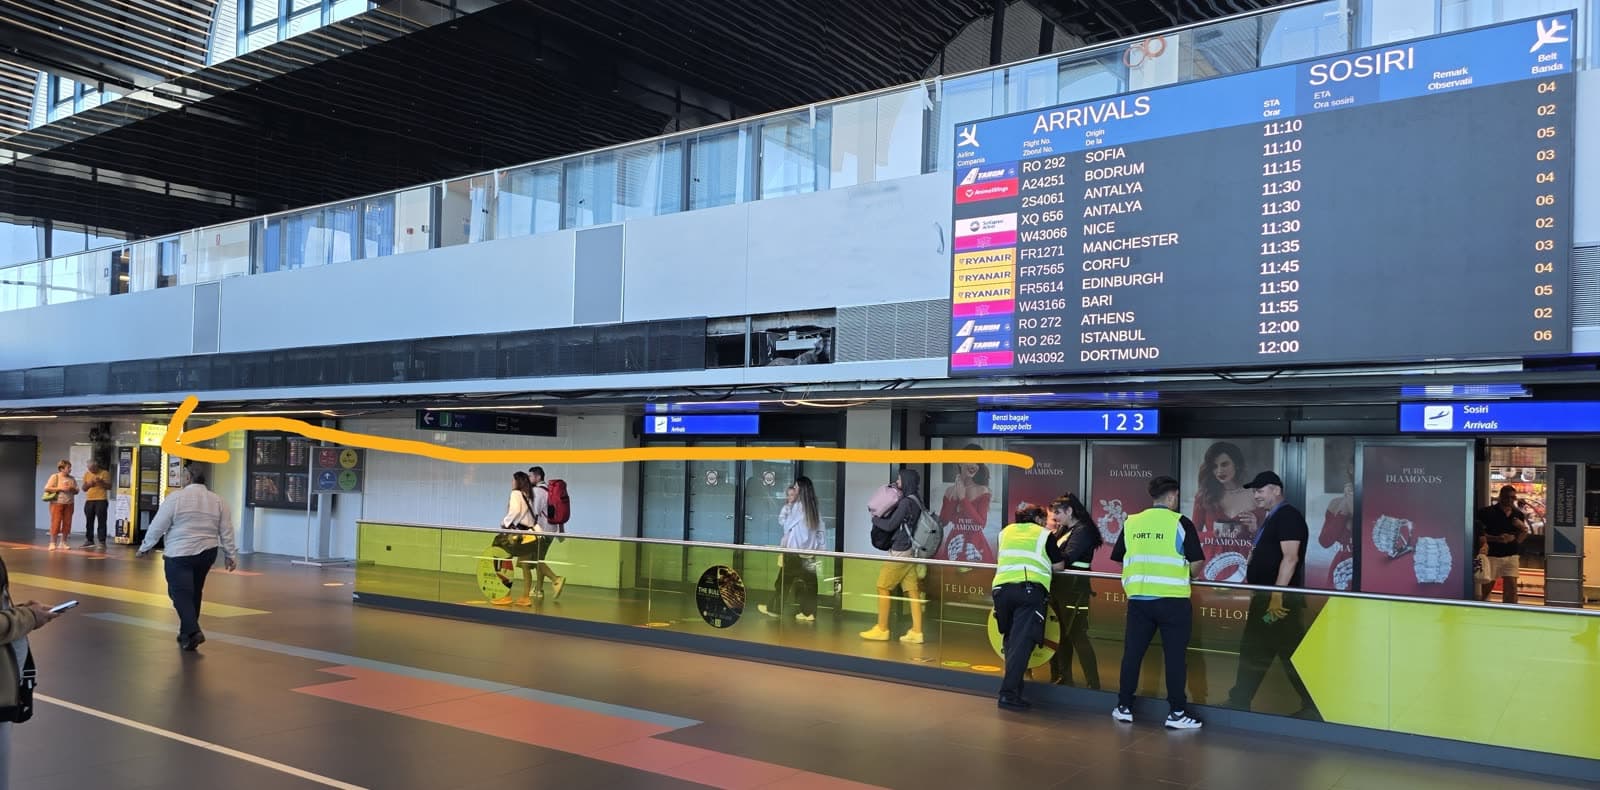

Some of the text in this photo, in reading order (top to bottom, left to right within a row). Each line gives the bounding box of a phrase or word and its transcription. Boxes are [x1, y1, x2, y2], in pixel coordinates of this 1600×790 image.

[1538, 52, 1557, 62] Belt
[1309, 47, 1415, 86] SOSIRI
[1433, 66, 1468, 79] Remark
[1531, 63, 1563, 74] Banda
[1537, 81, 1556, 94] 04
[1314, 90, 1331, 99] ETA
[1263, 99, 1280, 107] STA
[1313, 101, 1329, 109] Ora
[1033, 96, 1150, 134] ARRIVALS
[1263, 109, 1280, 117] Orar
[1537, 104, 1556, 116] 02
[1085, 129, 1104, 138] Origin
[1264, 119, 1302, 137] 11:10
[1536, 127, 1555, 139] 05
[1023, 140, 1039, 149] Flight
[1263, 139, 1302, 157] 11:10
[957, 151, 974, 159] Airline
[1085, 147, 1126, 164] SOFIA
[1536, 150, 1555, 161] 03
[1022, 157, 1066, 173] RO 292
[1085, 162, 1145, 181] BODRUM
[1262, 160, 1301, 177] 11:15
[1022, 175, 1065, 190] A24251
[1536, 172, 1555, 184] 04
[1084, 181, 1143, 200] ANTALYA
[1262, 180, 1301, 196] 11:30
[1022, 192, 1064, 208] 2S4061
[1535, 194, 1554, 206] 06
[1083, 200, 1142, 218] ANTALYA
[1261, 199, 1300, 216] 11:30
[1021, 210, 1063, 225] XQ 656
[1535, 217, 1554, 229] 02
[1083, 221, 1116, 236] NICE
[1261, 219, 1300, 236] 11:30
[1020, 227, 1067, 243] W43066
[1083, 233, 1179, 254] MANCHESTER
[1260, 239, 1300, 256] 11:35
[1535, 239, 1553, 251] 03
[965, 254, 1012, 265] RYANAIR
[1020, 246, 1064, 260] FR1271
[1020, 263, 1064, 278] FR7565
[1082, 256, 1130, 272] CORFU
[1260, 259, 1300, 275] 11:45
[1534, 262, 1553, 274] 04
[965, 271, 1011, 282] RYANAIR
[1082, 272, 1164, 290] EDINBURGH
[964, 288, 1010, 299] RYANAIR
[1019, 281, 1064, 295] FR5614
[1259, 279, 1299, 295] 11:50
[1534, 285, 1553, 296] 05
[1019, 299, 1066, 312] W43166
[1082, 295, 1113, 308] BARI
[1259, 300, 1299, 315] 11:55
[1080, 311, 1135, 326] ATHENS
[1534, 307, 1553, 319] 02
[1018, 316, 1061, 329] RO 272
[1259, 320, 1299, 334] 12:00
[1018, 334, 1061, 347] RO 262
[1081, 330, 1146, 344] ISTANBUL
[1534, 330, 1552, 341] 06
[1258, 340, 1299, 354] 12:00
[1018, 352, 1064, 365] W43092
[1080, 347, 1160, 361] DORTMUND
[1464, 405, 1488, 414] Sosiri
[992, 423, 1017, 431] Baggage
[1009, 414, 1029, 422] bagaje
[1102, 413, 1109, 431] 1
[1116, 413, 1127, 431] 2
[1133, 413, 1144, 431] 3
[1464, 420, 1498, 430] Arrivals
[1024, 468, 1064, 476] DIAMONDS
[1109, 469, 1153, 478] DIAMONDS
[1385, 474, 1442, 484] DIAMONDS
[1132, 532, 1164, 540] PORTRI
[1204, 537, 1252, 547] DIAMONDS
[945, 584, 984, 595] TEILOR
